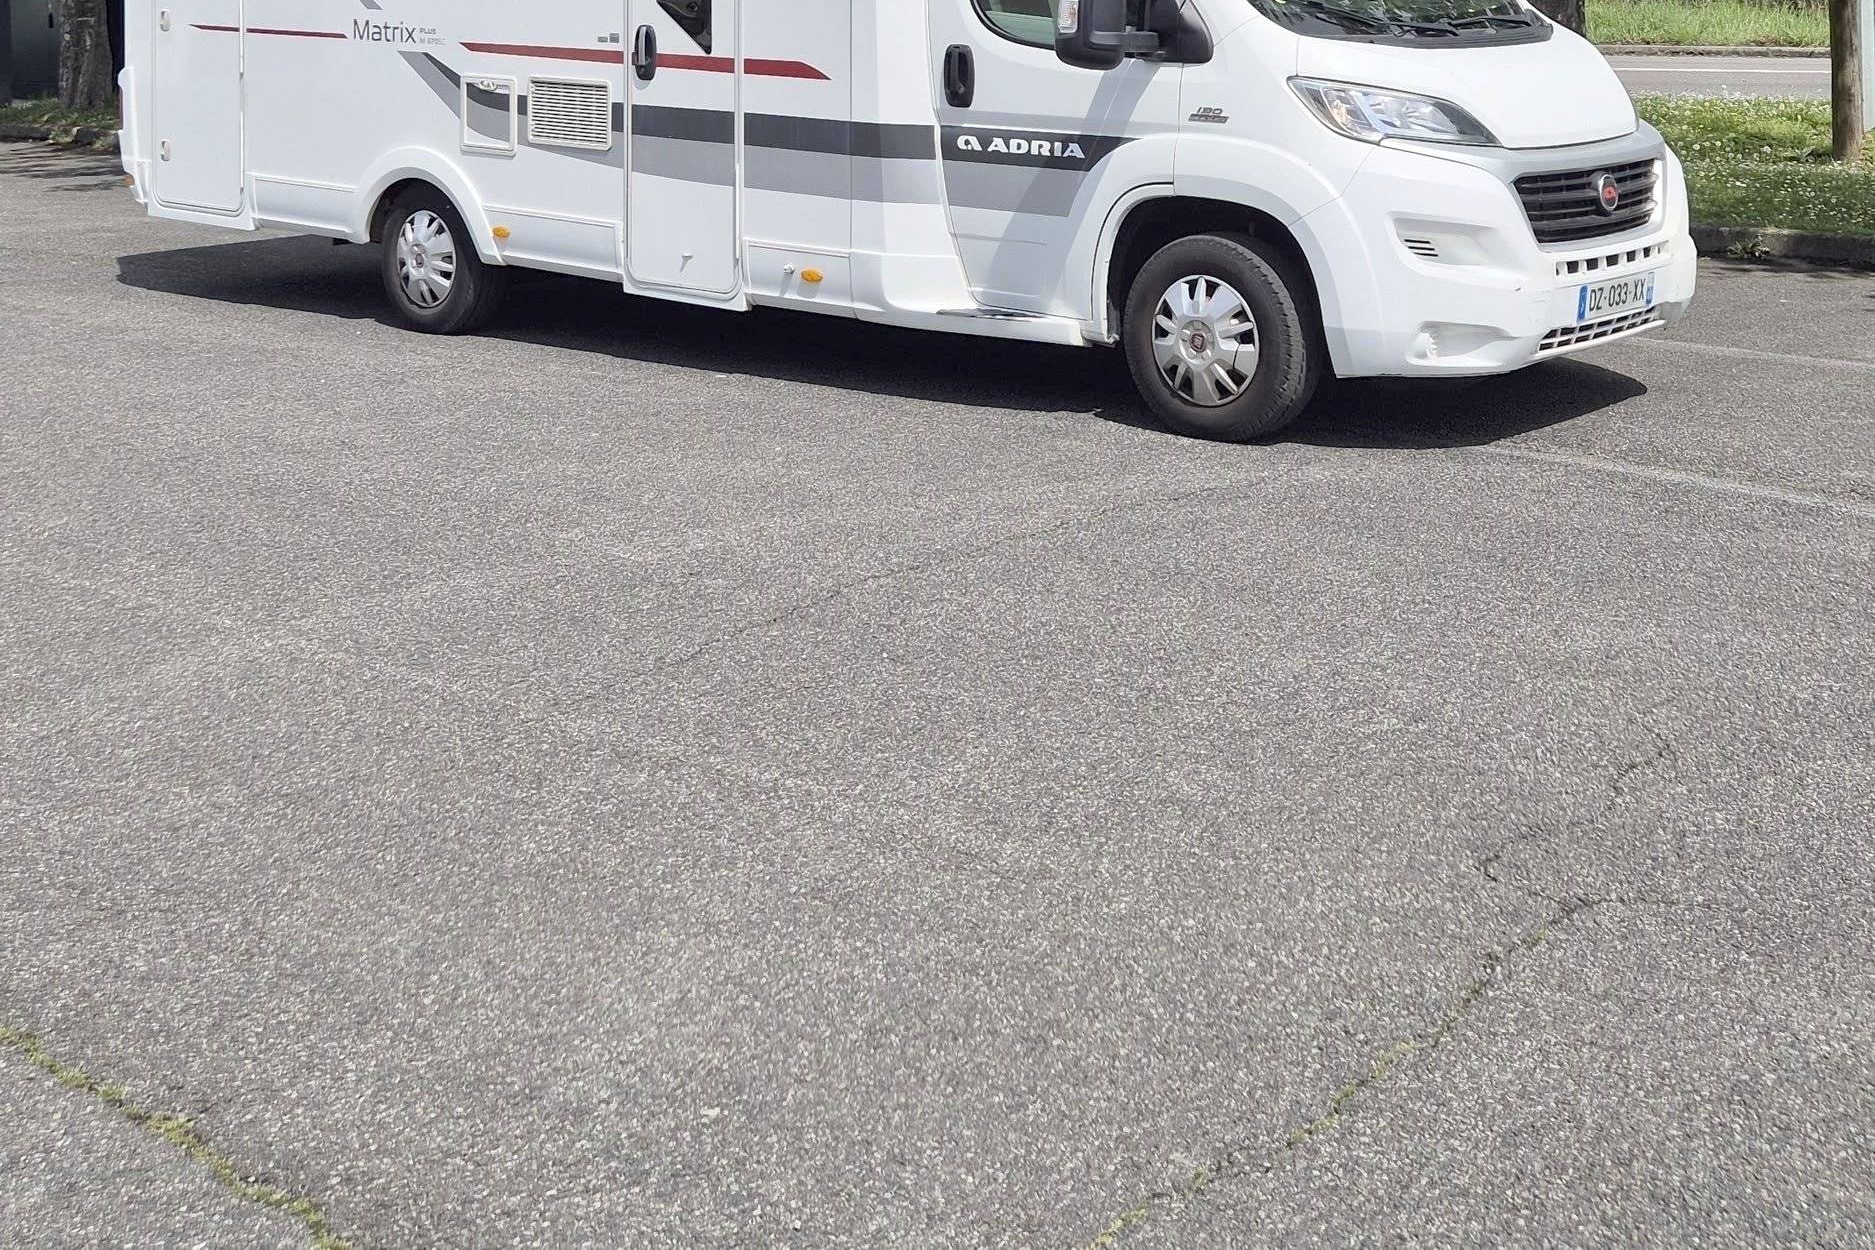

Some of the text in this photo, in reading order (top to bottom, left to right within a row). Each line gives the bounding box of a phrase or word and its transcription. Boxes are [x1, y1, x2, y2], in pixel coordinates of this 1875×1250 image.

[353, 18, 437, 44] Matrix PLUS
[987, 137, 1086, 159] ADRIA
